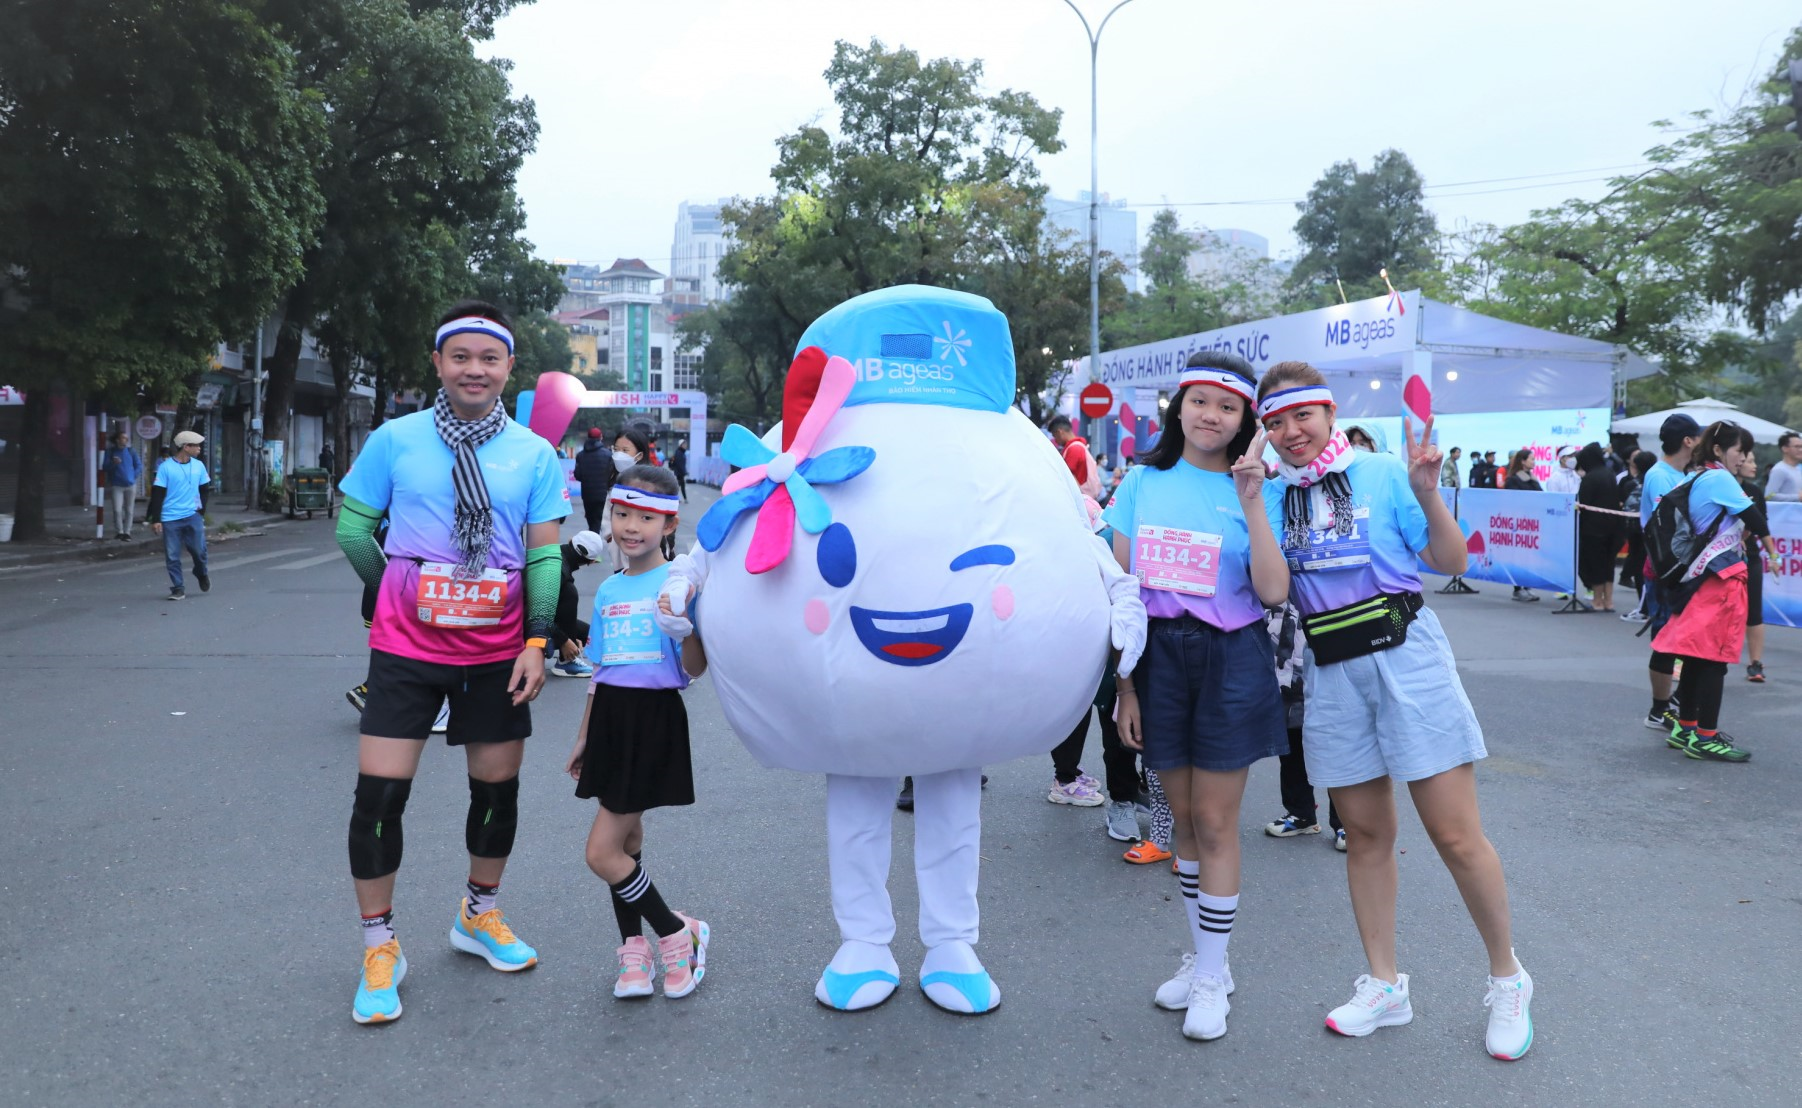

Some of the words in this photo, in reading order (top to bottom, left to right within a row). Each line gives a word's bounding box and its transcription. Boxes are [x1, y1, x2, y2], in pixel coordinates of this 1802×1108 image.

[1325, 319, 1350, 347] MB
[1353, 317, 1395, 350] ageas
[888, 361, 954, 386] ageas
[600, 393, 640, 405] NISH
[1308, 431, 1349, 477] 2022
[1140, 543, 1212, 569] 1134-2
[424, 580, 501, 604] 1134-4
